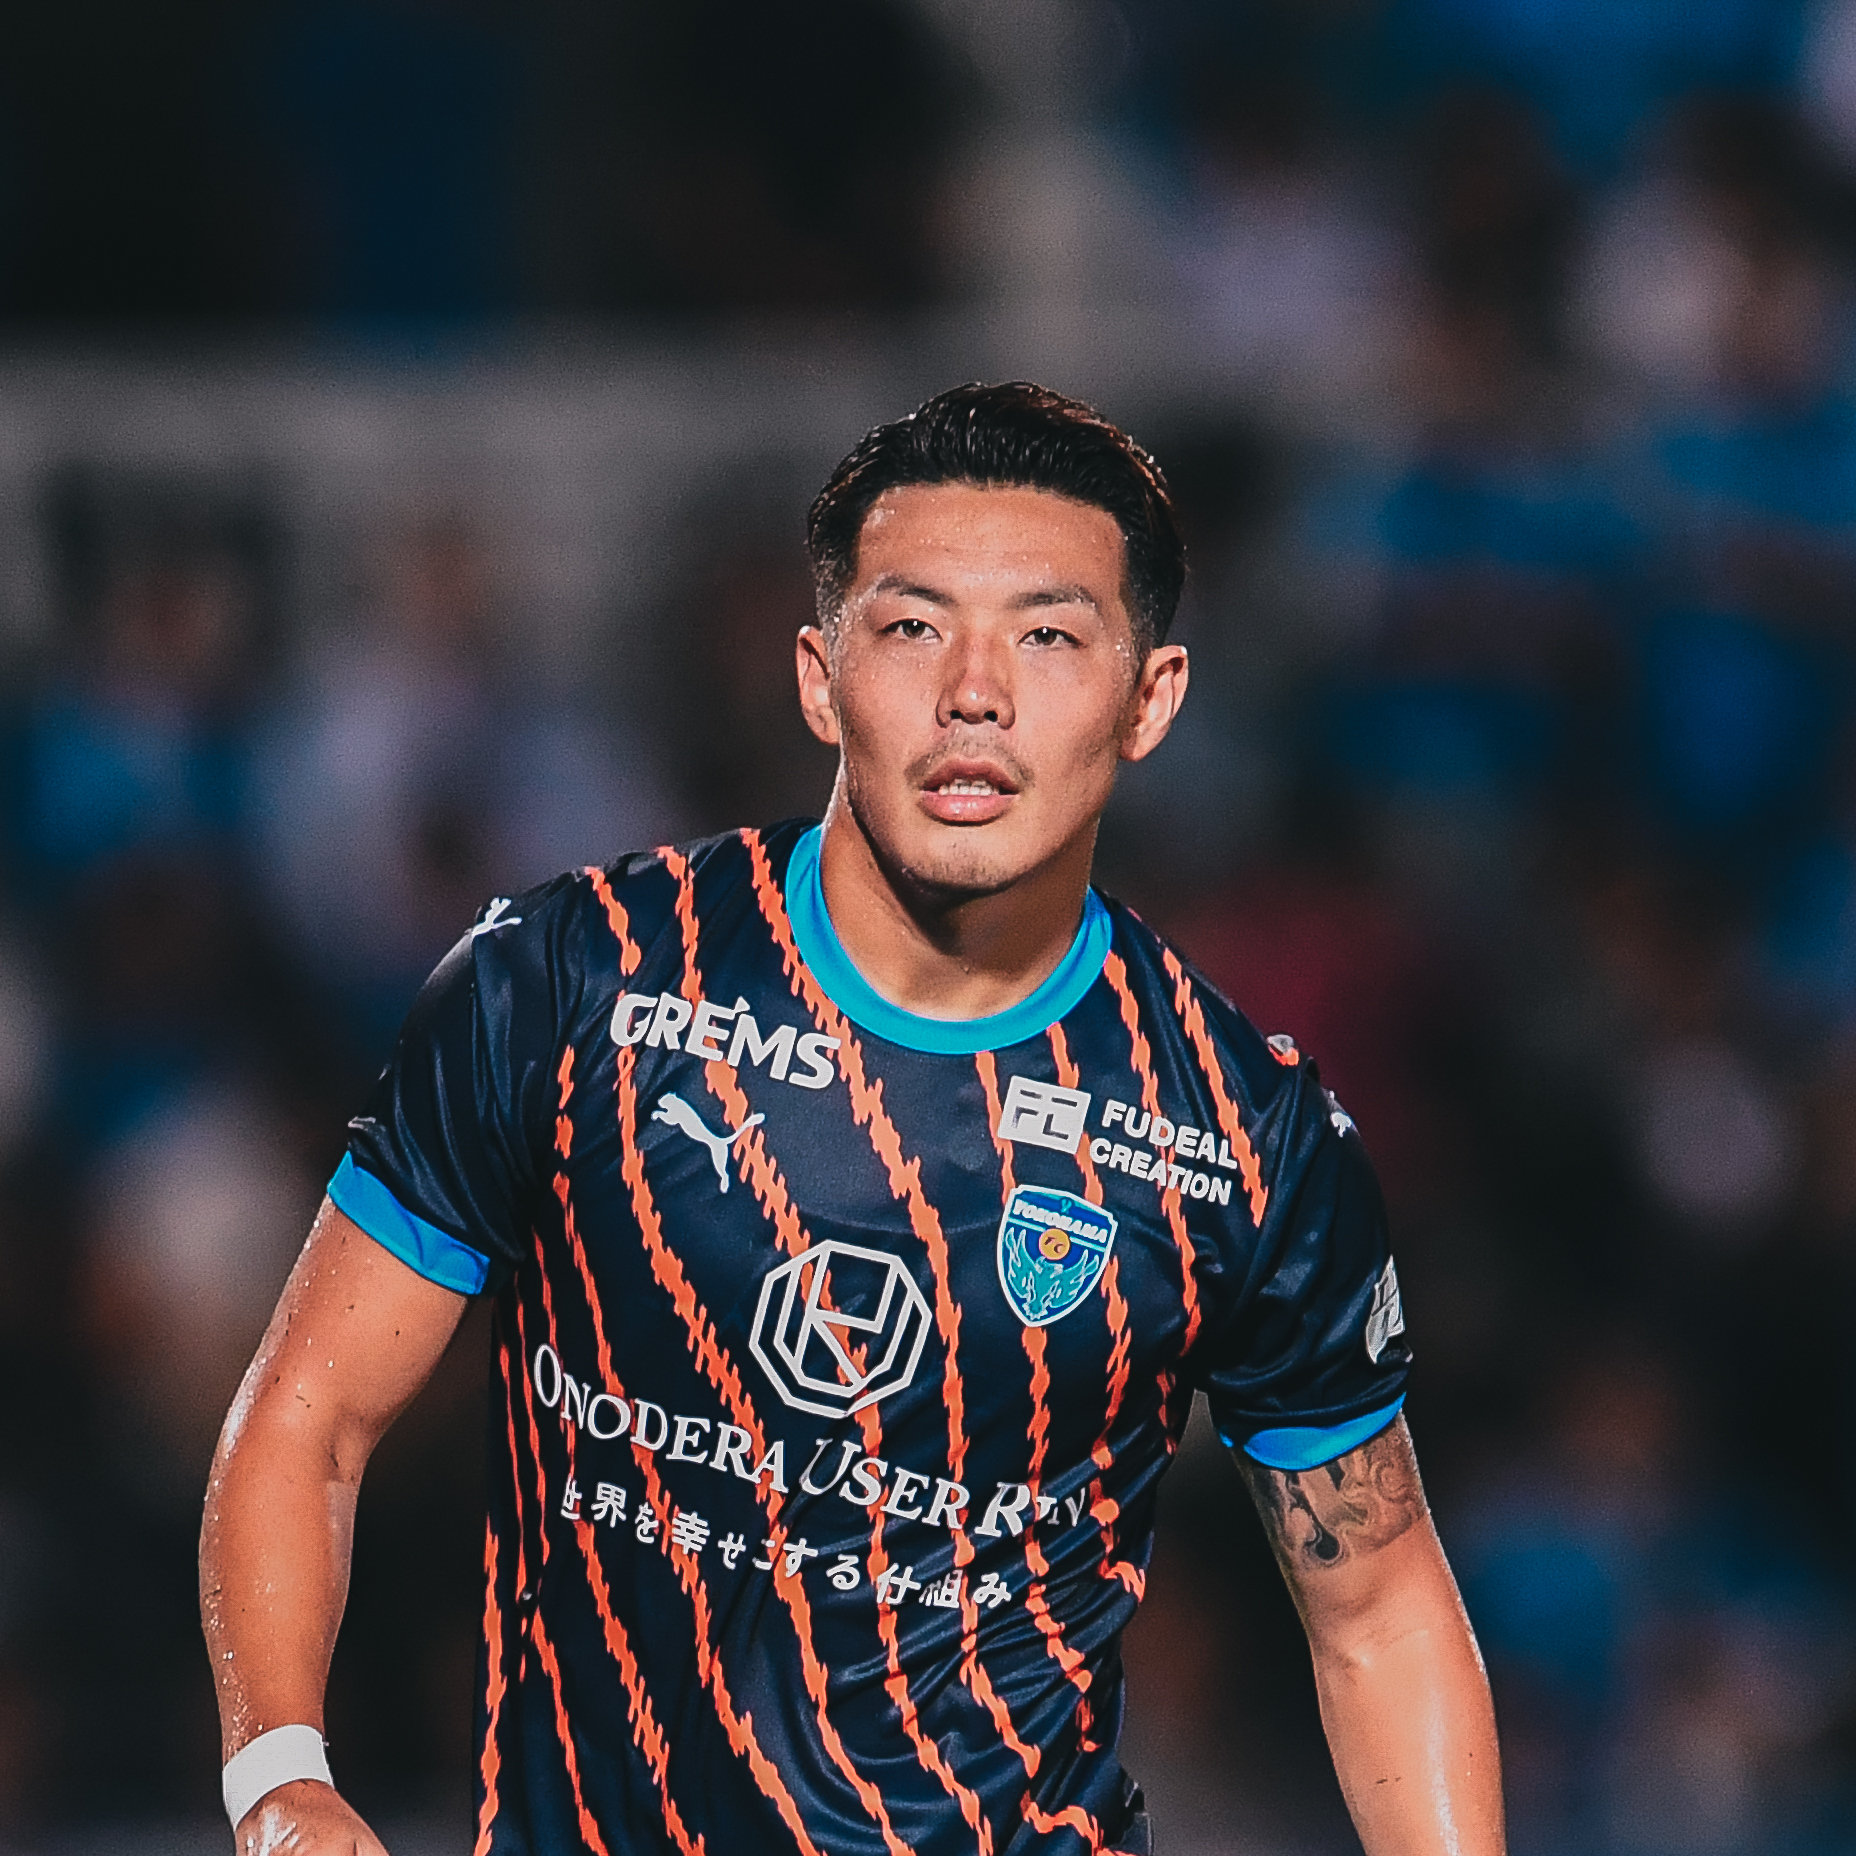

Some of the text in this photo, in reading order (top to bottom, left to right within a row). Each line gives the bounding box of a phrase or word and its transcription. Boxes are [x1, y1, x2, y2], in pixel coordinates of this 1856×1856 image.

[610, 992, 842, 1090] GREMS
[1089, 1137, 1232, 1206] CREATION
[1101, 1098, 1238, 1170] FUDEAL
[533, 1343, 789, 1493] ONODERA
[799, 1438, 970, 1531] USER
